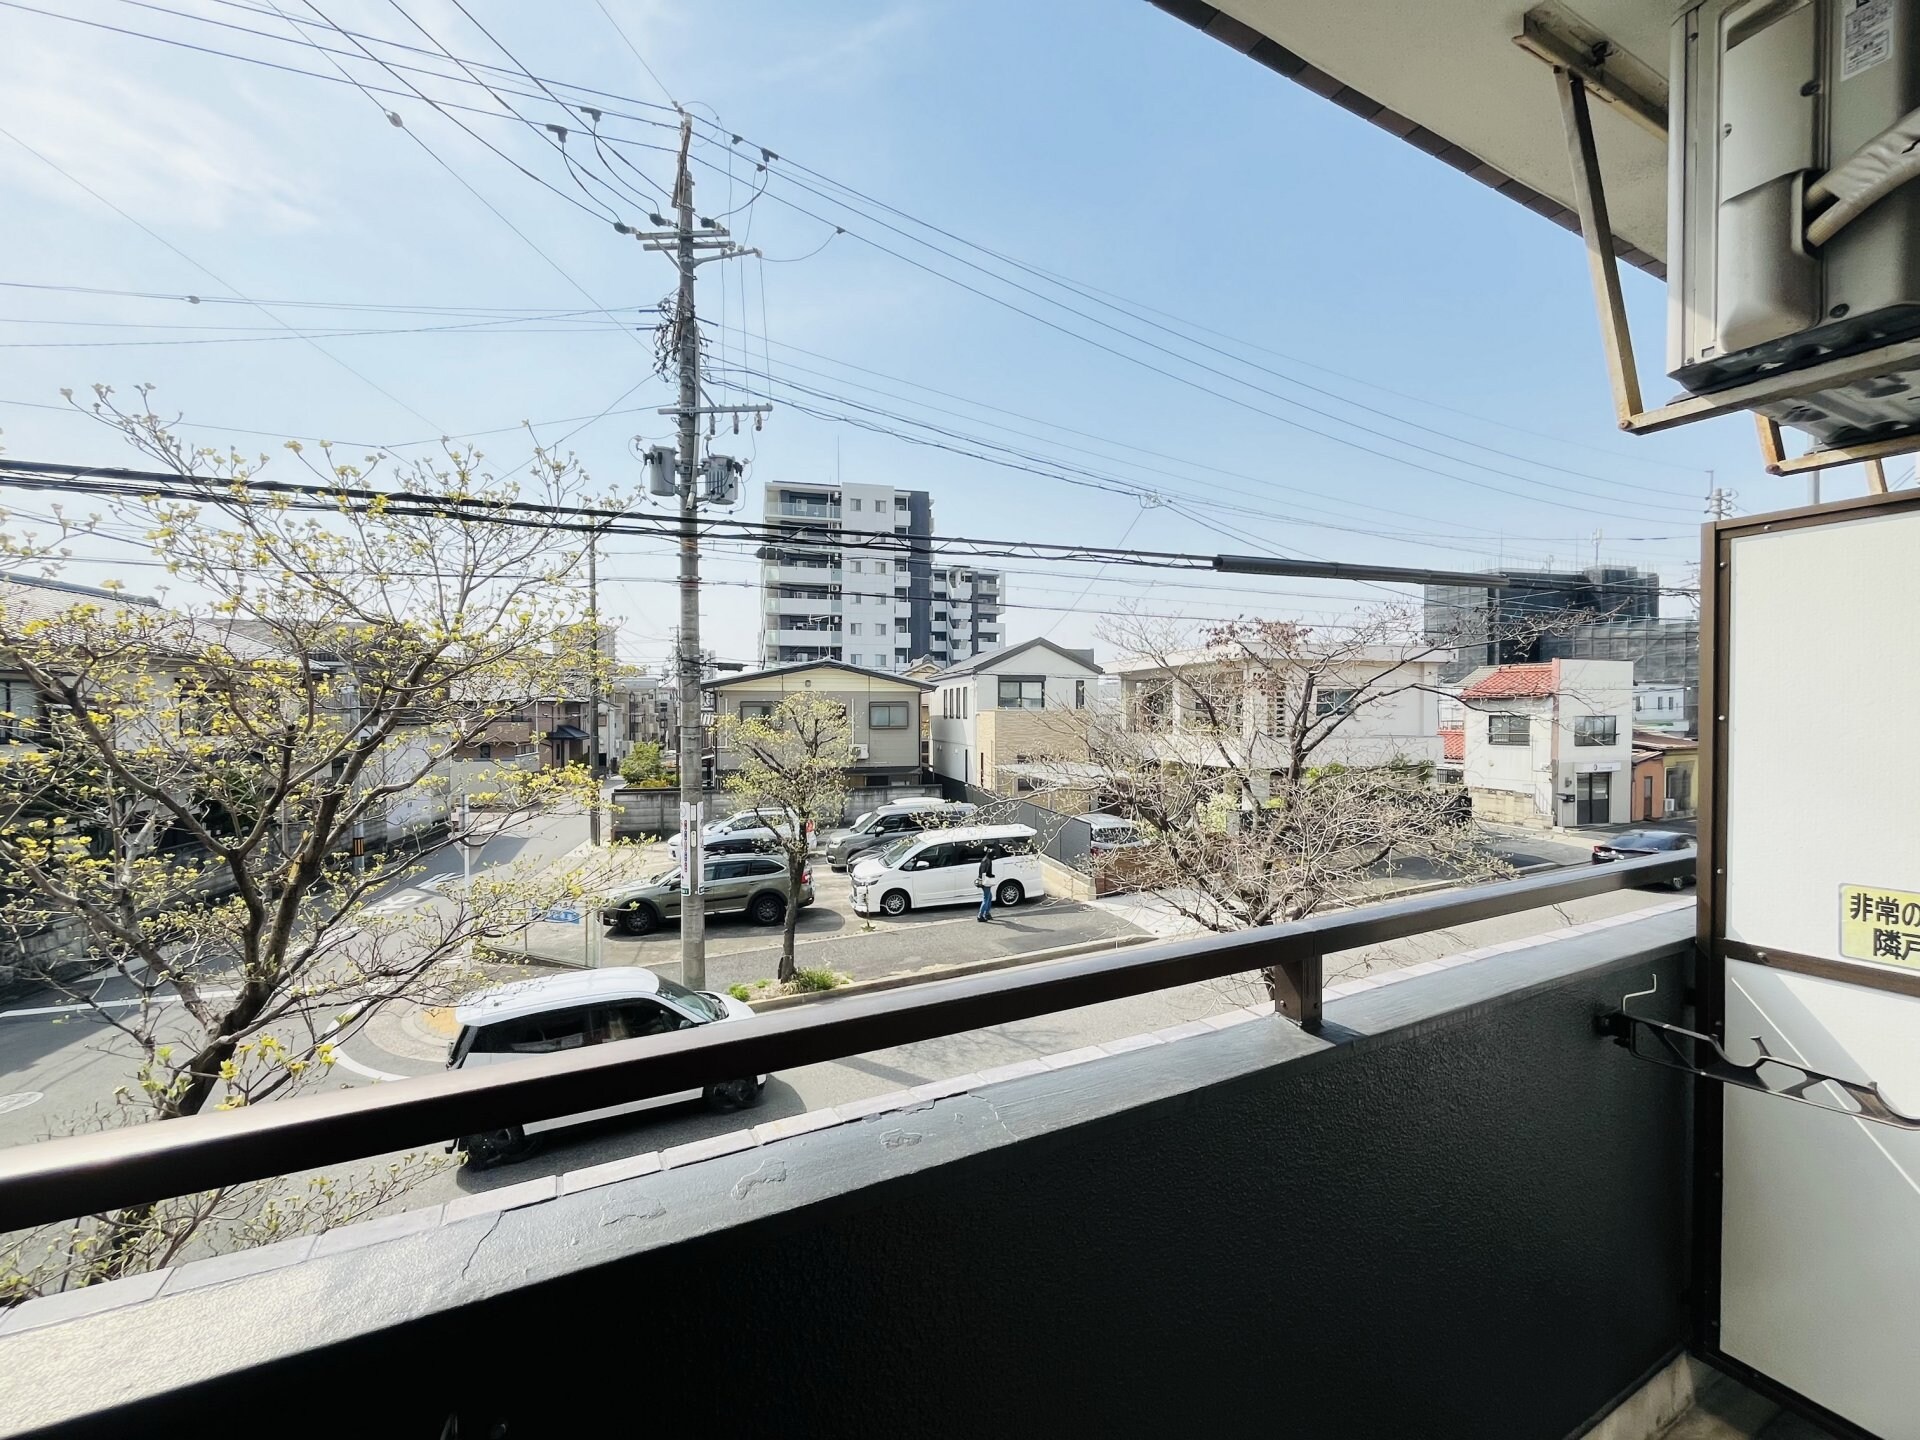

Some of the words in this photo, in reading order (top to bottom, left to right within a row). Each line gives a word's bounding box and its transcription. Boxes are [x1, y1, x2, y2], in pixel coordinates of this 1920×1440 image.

[1849, 893, 1920, 927] 非常の
[1873, 928, 1920, 960] 隣戸
